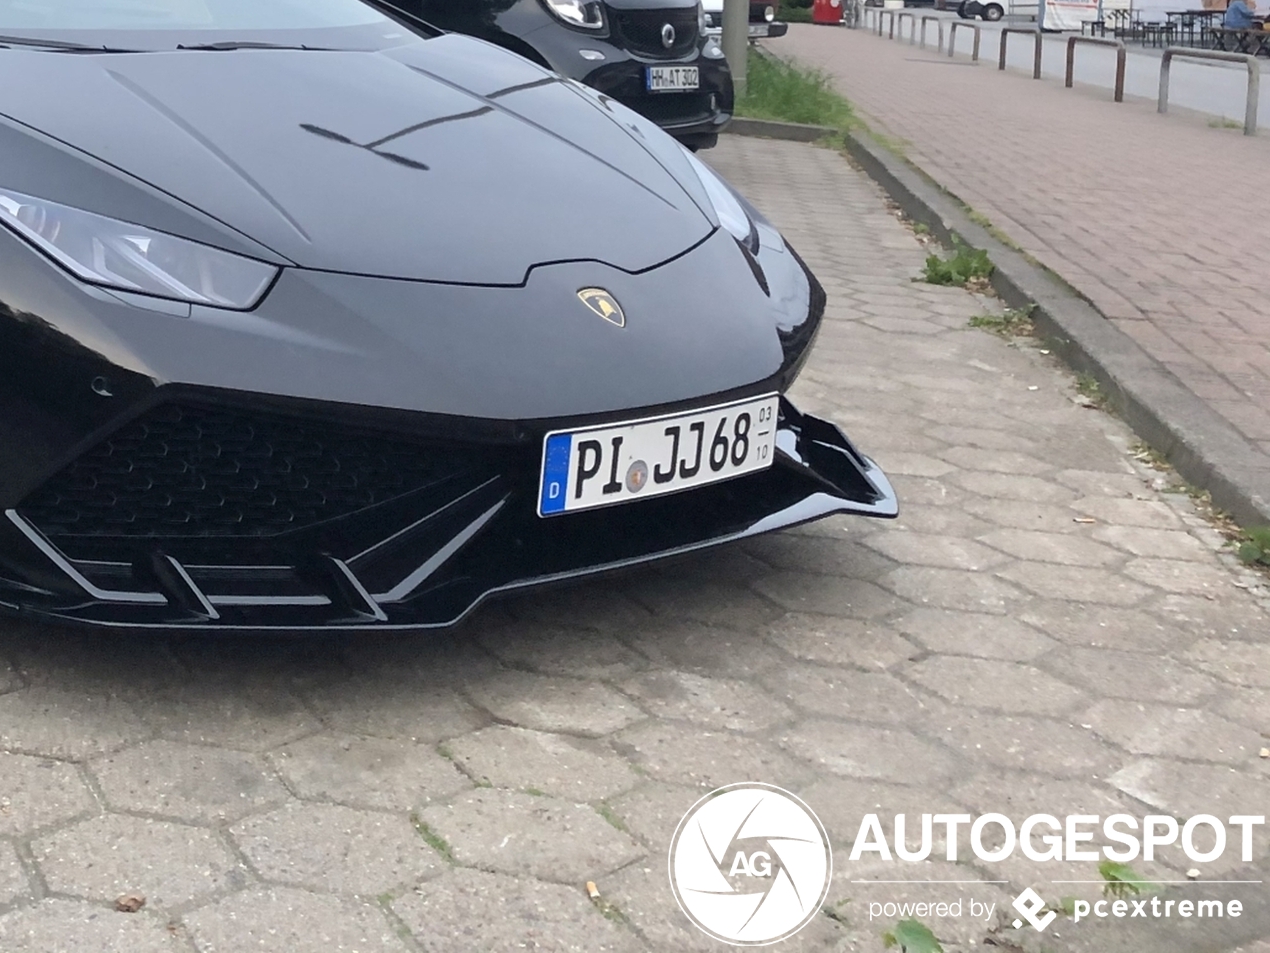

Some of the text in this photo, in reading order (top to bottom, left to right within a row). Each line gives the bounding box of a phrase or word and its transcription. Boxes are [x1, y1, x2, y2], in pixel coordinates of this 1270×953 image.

[652, 69, 664, 87] HH
[669, 69, 680, 87] AT
[759, 406, 772, 423] 03
[575, 436, 624, 499] PI
[549, 482, 559, 499] D
